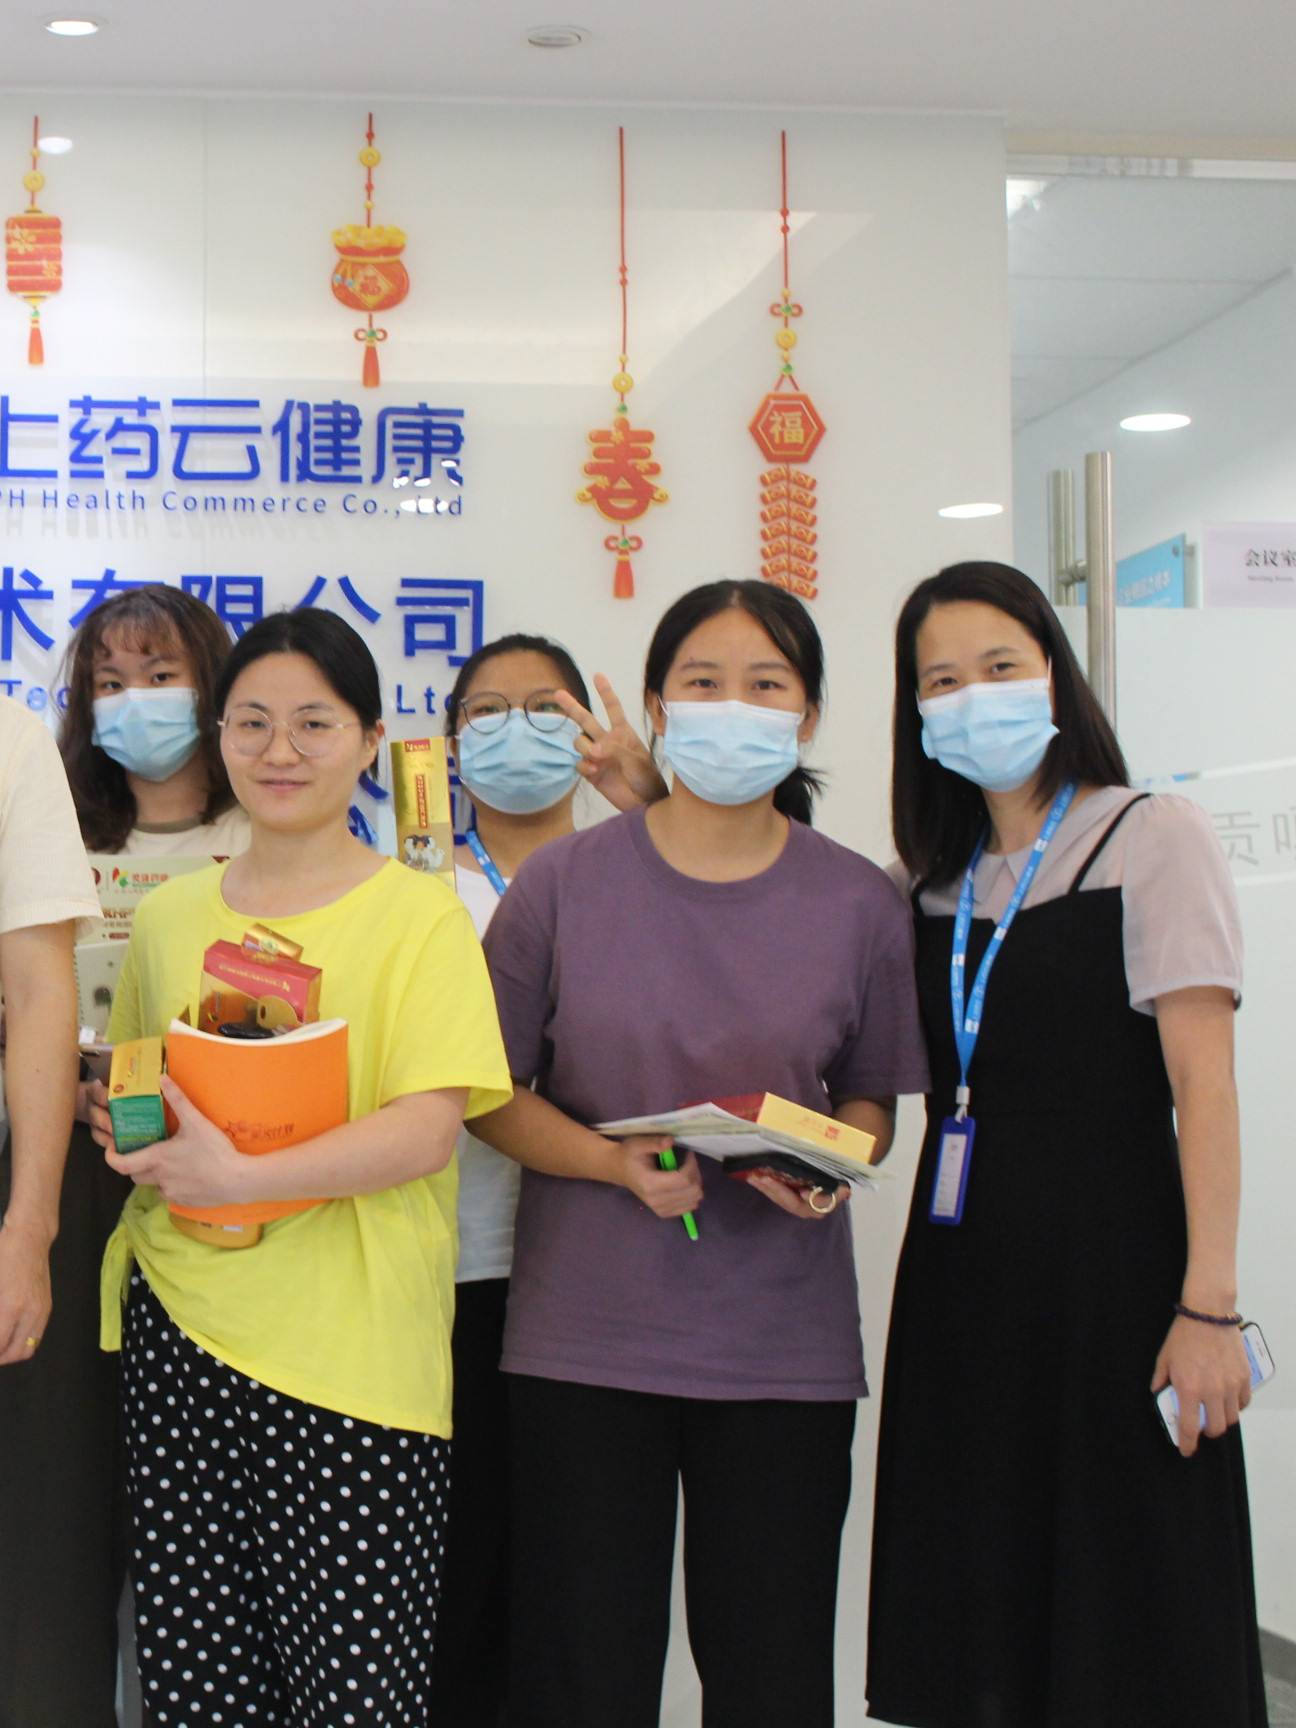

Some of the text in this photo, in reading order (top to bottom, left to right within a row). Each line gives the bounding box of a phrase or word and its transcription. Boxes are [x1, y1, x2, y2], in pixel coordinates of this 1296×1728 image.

[769, 411, 805, 444] 福
[583, 417, 661, 522] 春
[42, 489, 145, 511] Health
[162, 491, 327, 514] Commerce
